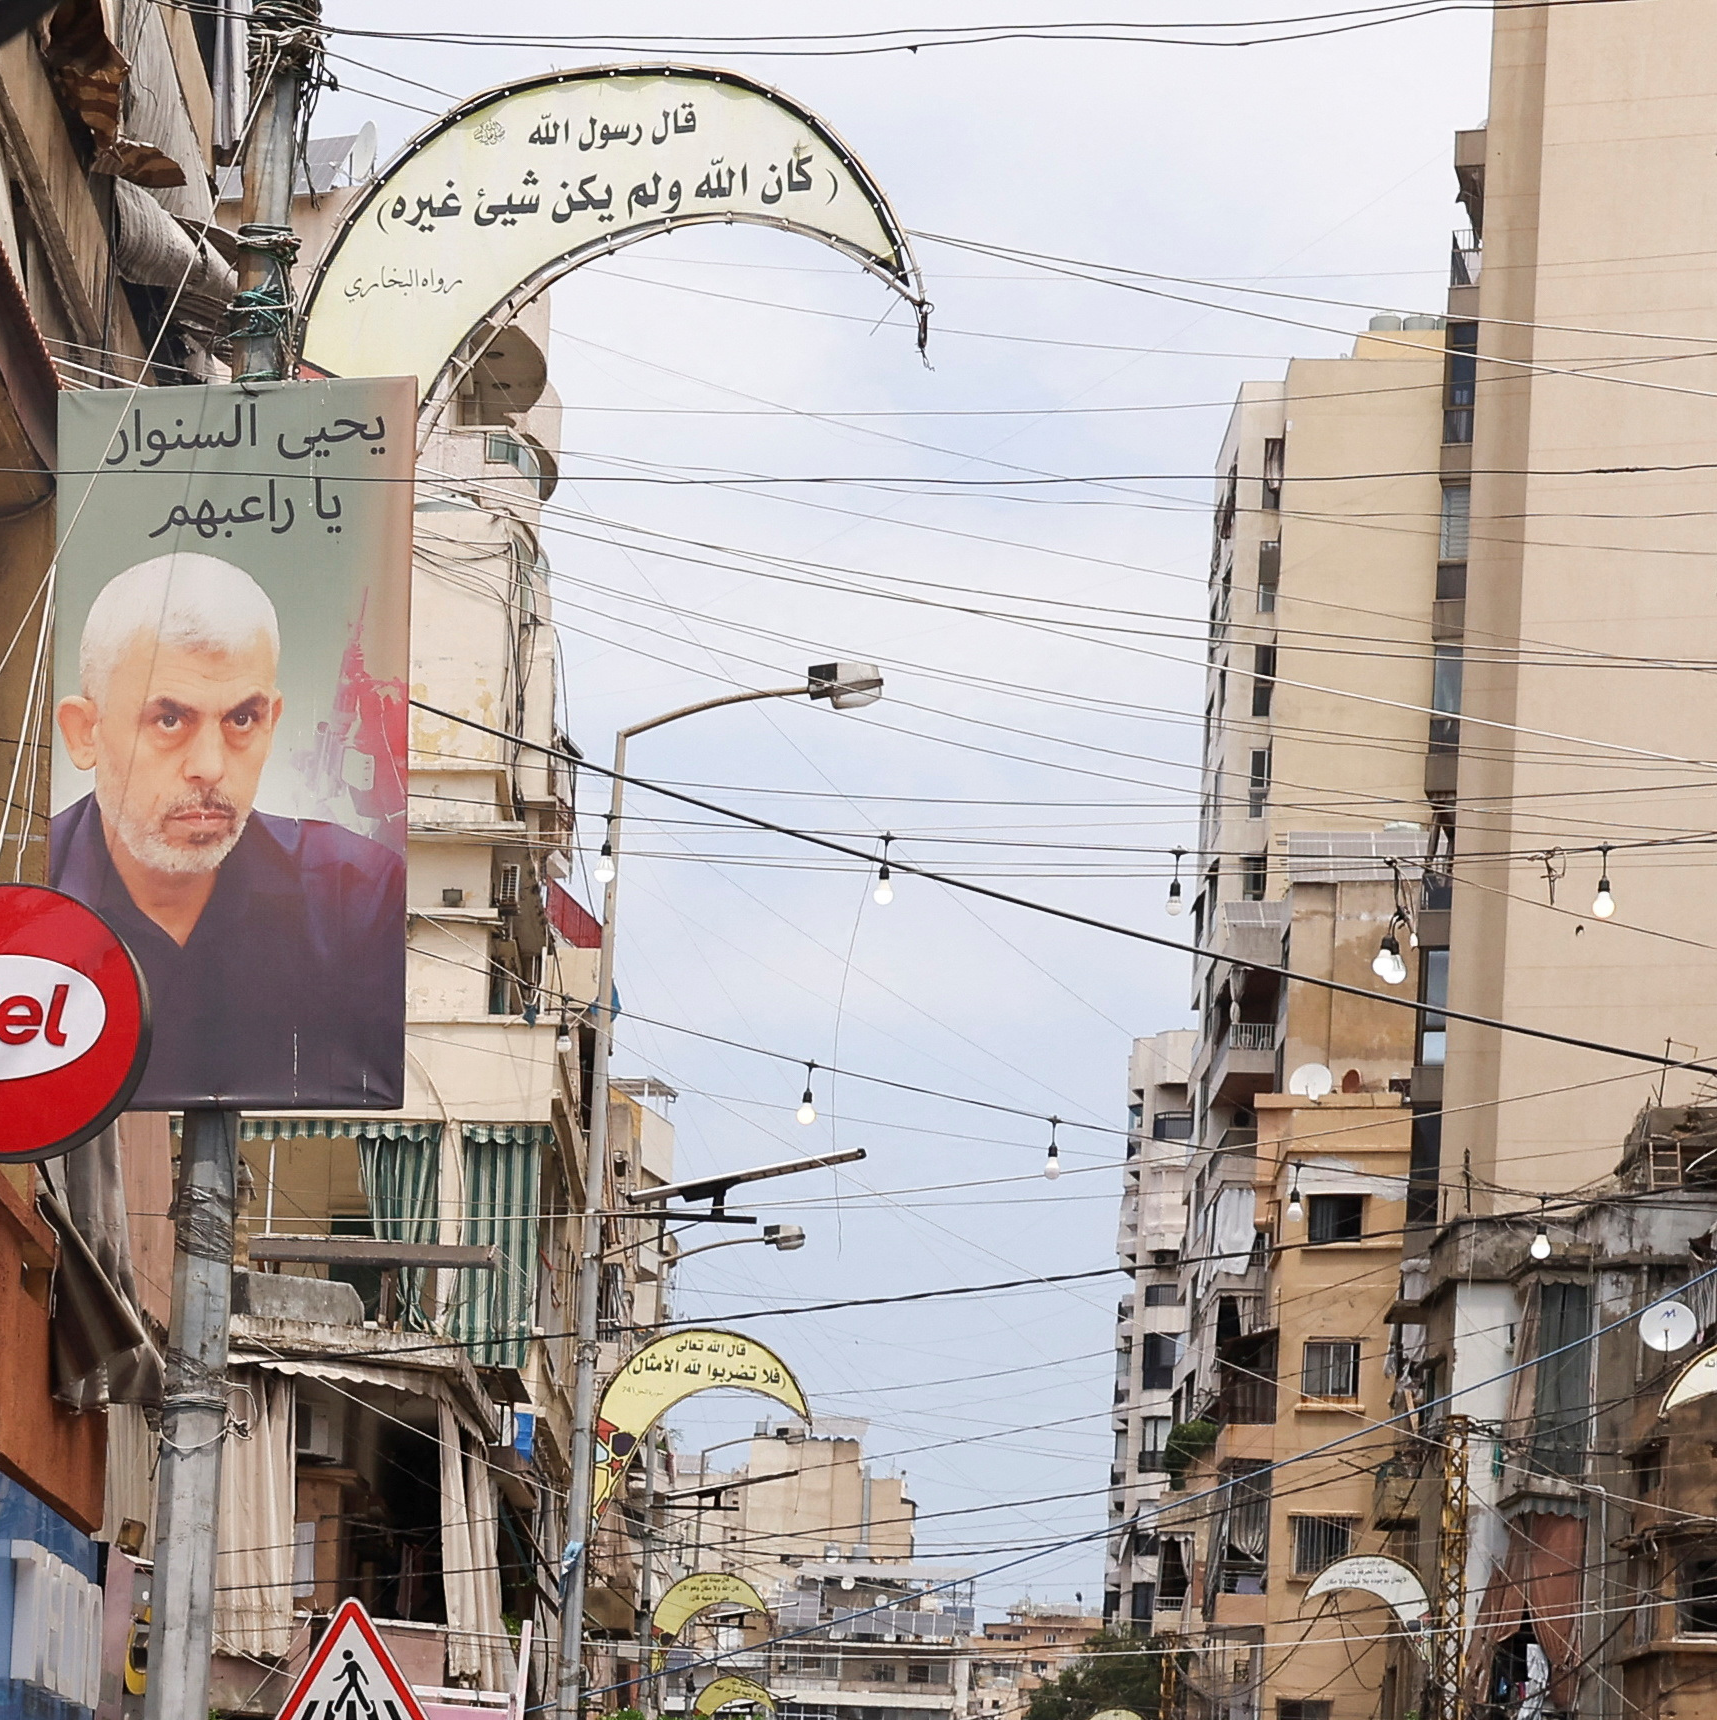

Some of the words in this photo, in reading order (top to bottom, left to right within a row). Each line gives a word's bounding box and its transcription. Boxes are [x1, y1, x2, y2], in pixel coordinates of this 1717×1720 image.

[578, 116, 643, 151] رسول
[652, 102, 696, 145] قال
[551, 173, 615, 223] يكن
[627, 171, 682, 219] ولم
[344, 265, 420, 302] البخاري
[421, 267, 463, 295] رواه
[105, 403, 258, 466] السنوار
[277, 415, 386, 459] يحيى
[315, 477, 342, 533] يا
[675, 1339, 703, 1353] تعالى
[727, 1343, 746, 1358] قال
[707, 1362, 756, 1382] تضربوا
